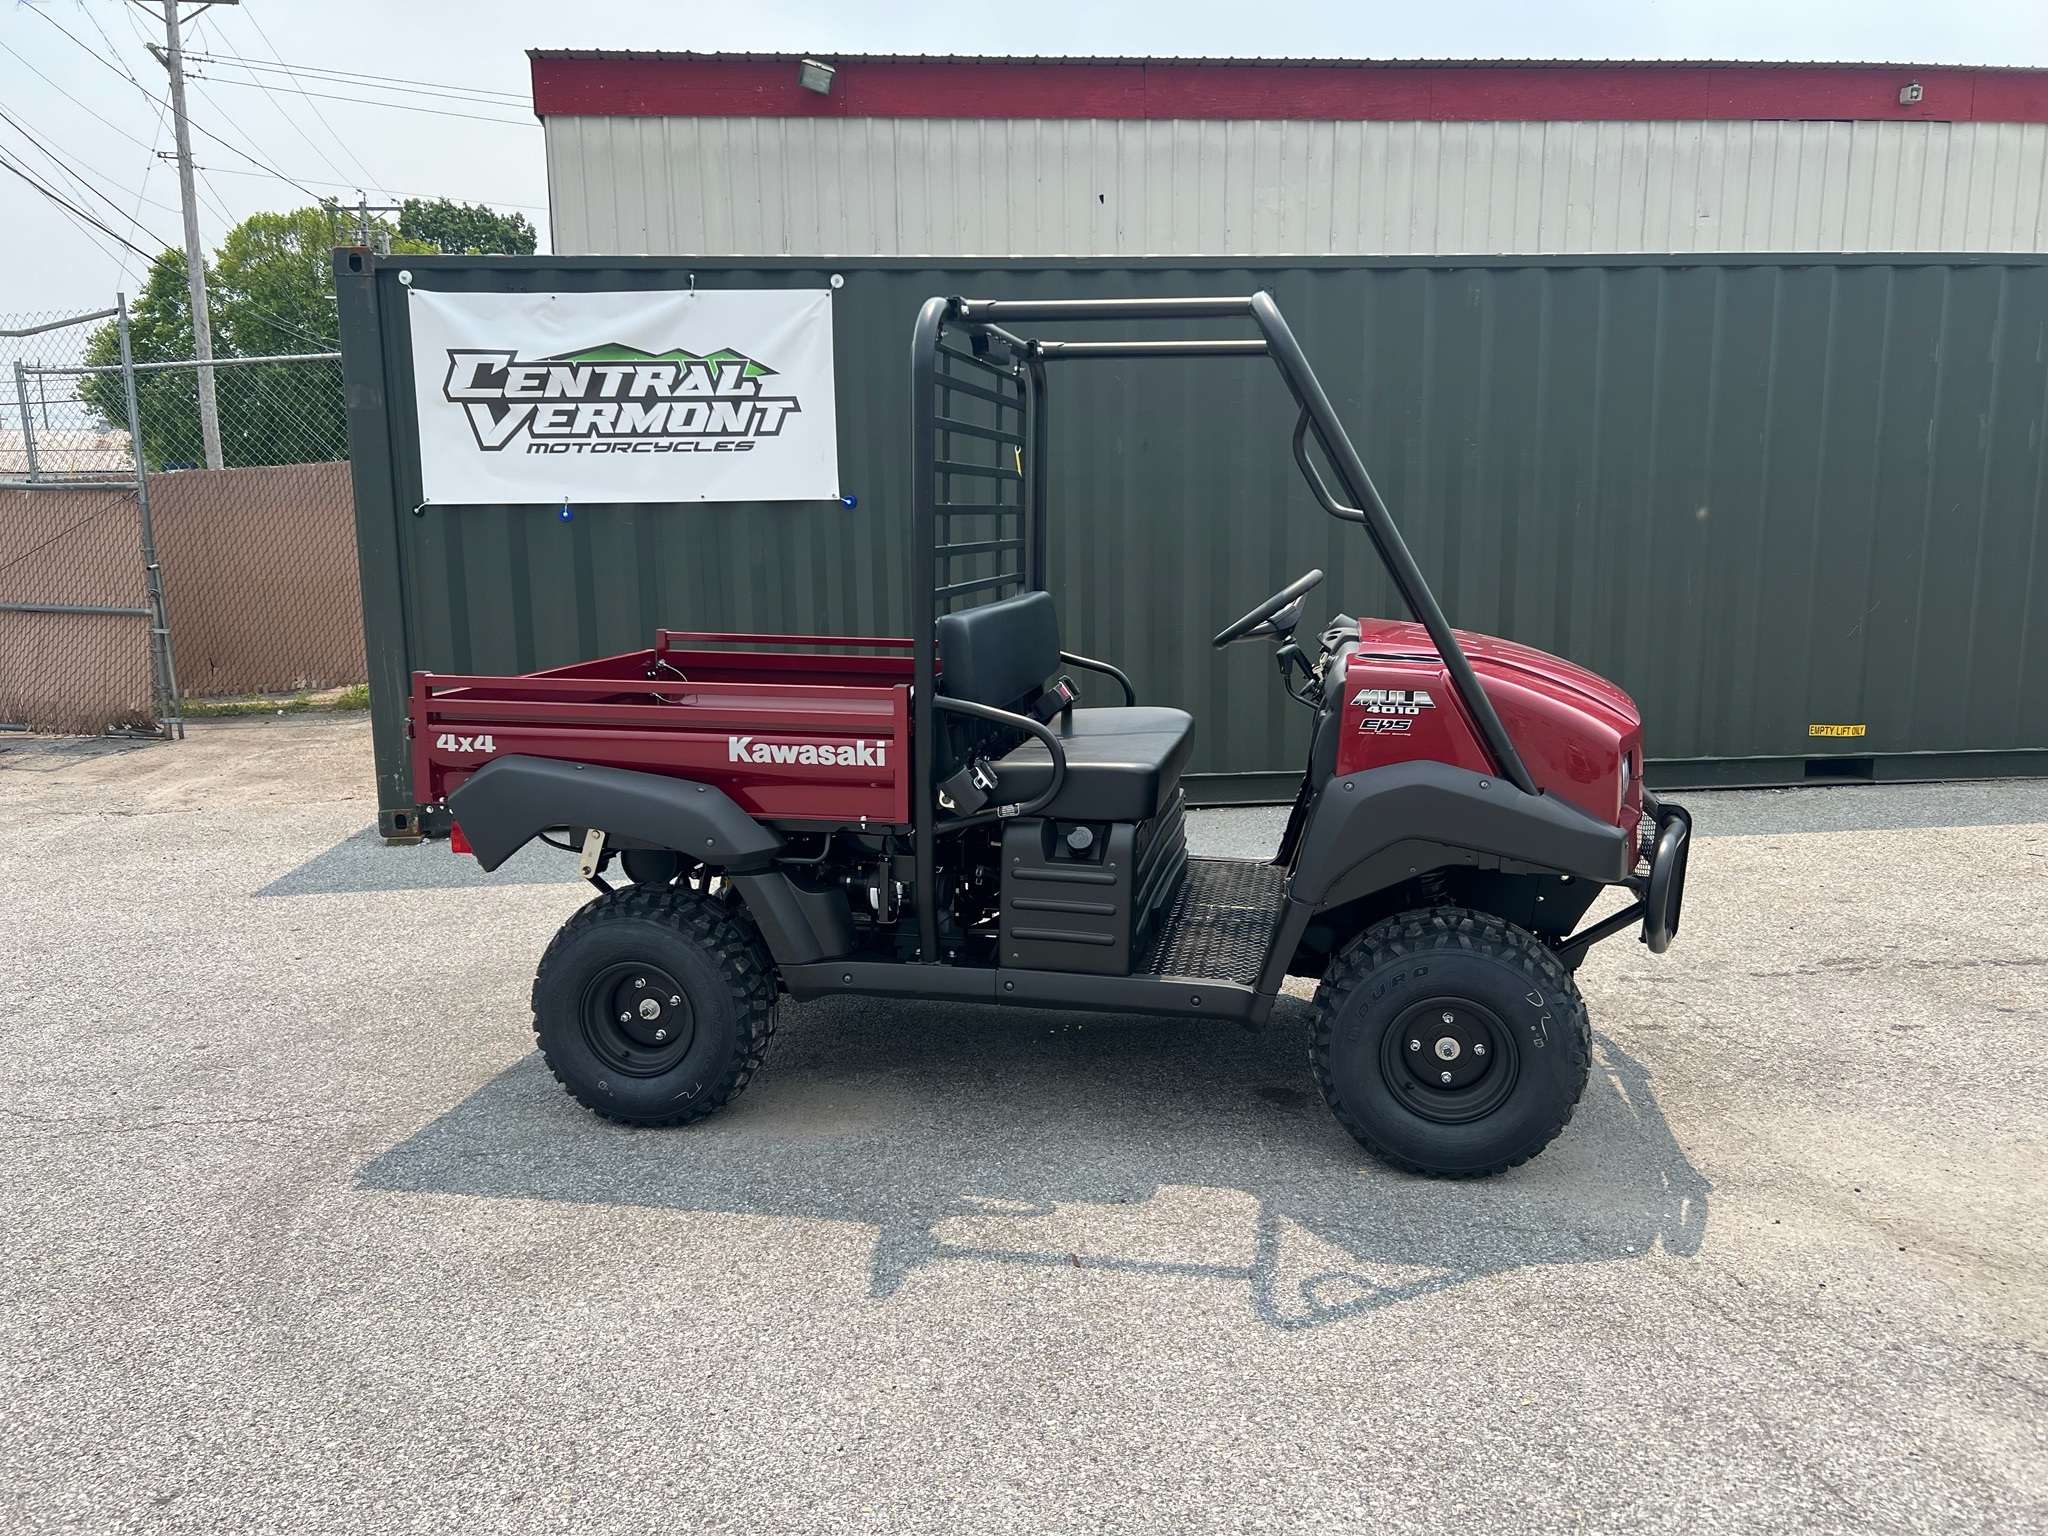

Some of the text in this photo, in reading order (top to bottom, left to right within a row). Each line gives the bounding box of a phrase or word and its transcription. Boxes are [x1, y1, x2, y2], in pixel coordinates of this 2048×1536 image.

[444, 350, 759, 401] CENTRAL
[464, 400, 799, 450] VERMONT
[526, 440, 756, 454] MOTORCYCLES
[1350, 689, 1436, 708] MULE
[1366, 706, 1420, 715] 4010
[1810, 726, 1835, 735] EMPTY
[1836, 727, 1850, 735] LIFT
[436, 734, 497, 753] 4x4
[728, 736, 886, 767] Kawasaki
[1355, 965, 1431, 1021] DURO
